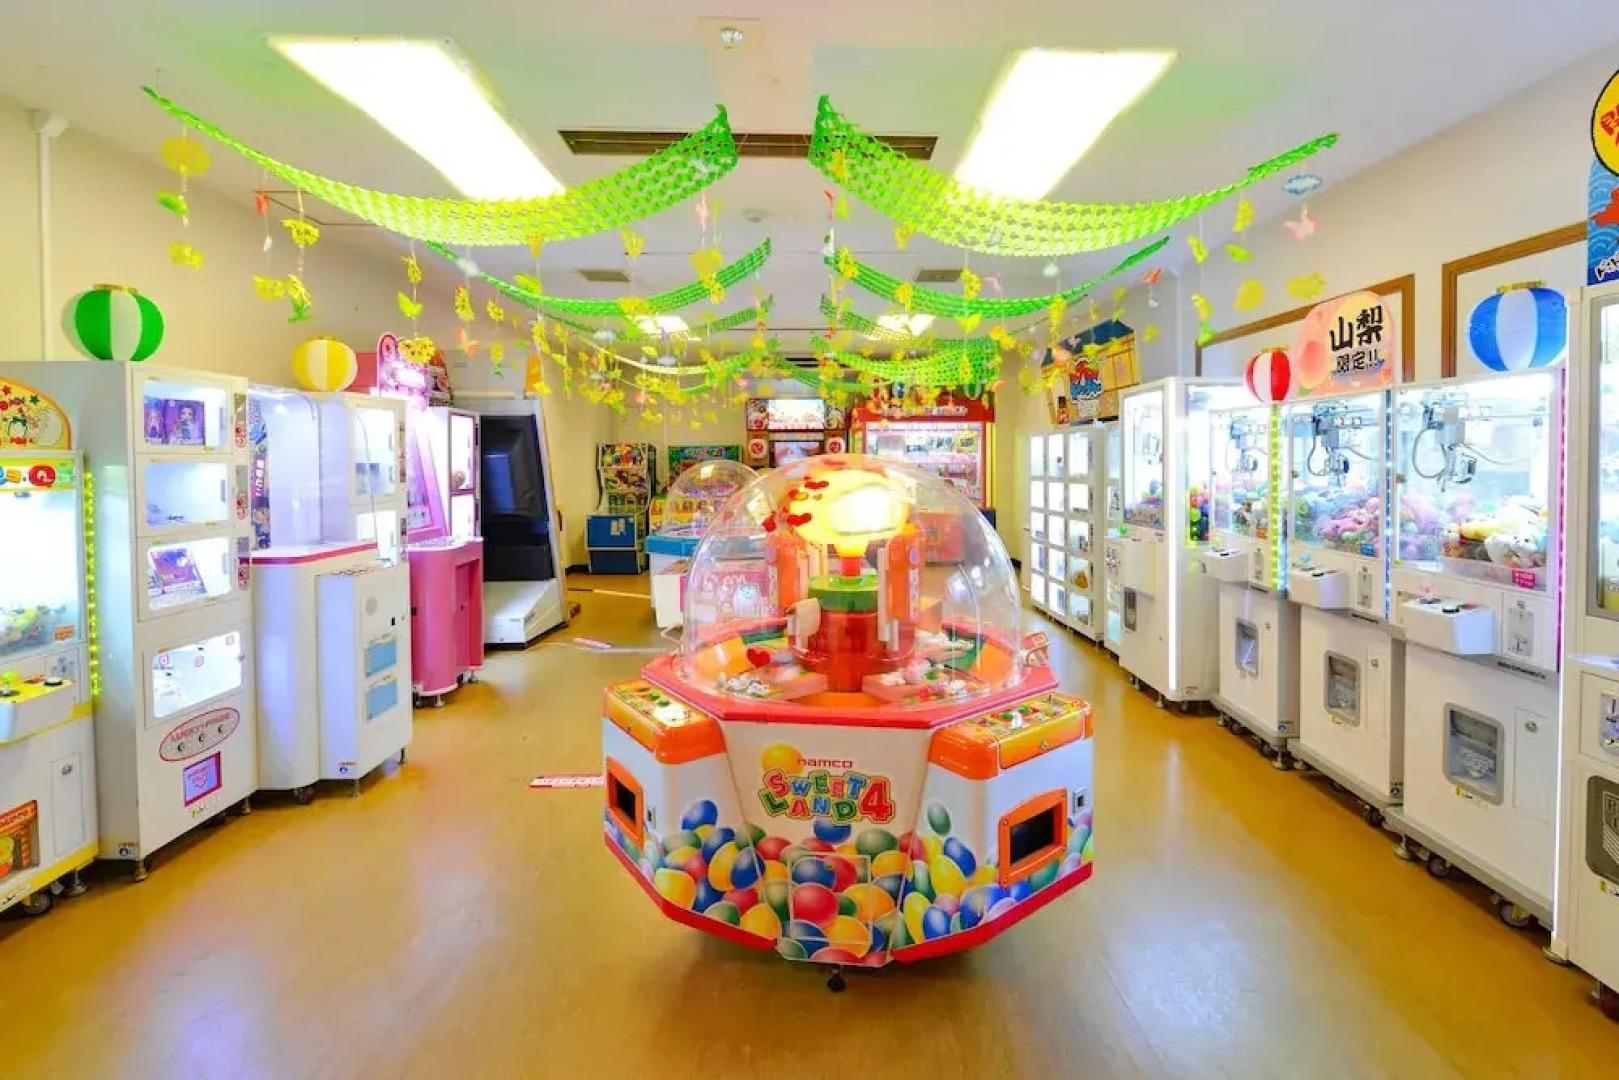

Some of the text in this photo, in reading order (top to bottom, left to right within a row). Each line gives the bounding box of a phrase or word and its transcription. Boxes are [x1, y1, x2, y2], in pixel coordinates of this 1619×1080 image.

[1329, 305, 1383, 351] 山梨
[798, 758, 854, 769] namco
[761, 776, 894, 823] LAND 4
[764, 770, 867, 799] SWEET
